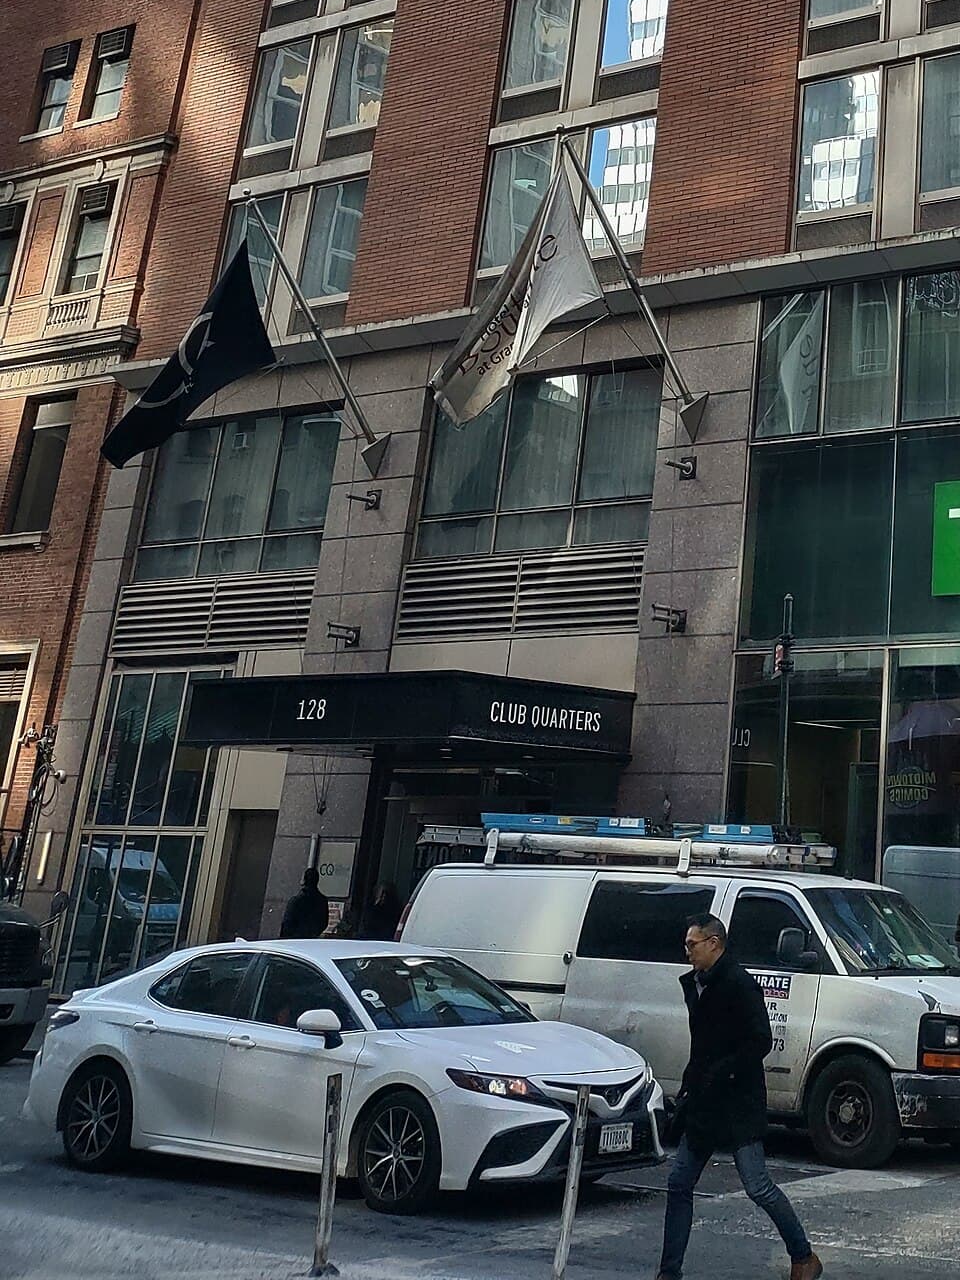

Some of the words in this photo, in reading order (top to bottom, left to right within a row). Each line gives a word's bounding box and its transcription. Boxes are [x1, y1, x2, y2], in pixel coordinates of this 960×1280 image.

[477, 360, 492, 376] at
[296, 699, 327, 720] 128
[490, 701, 526, 725] CLUB
[531, 705, 601, 733] QUARTERS
[754, 975, 789, 989] RATE
